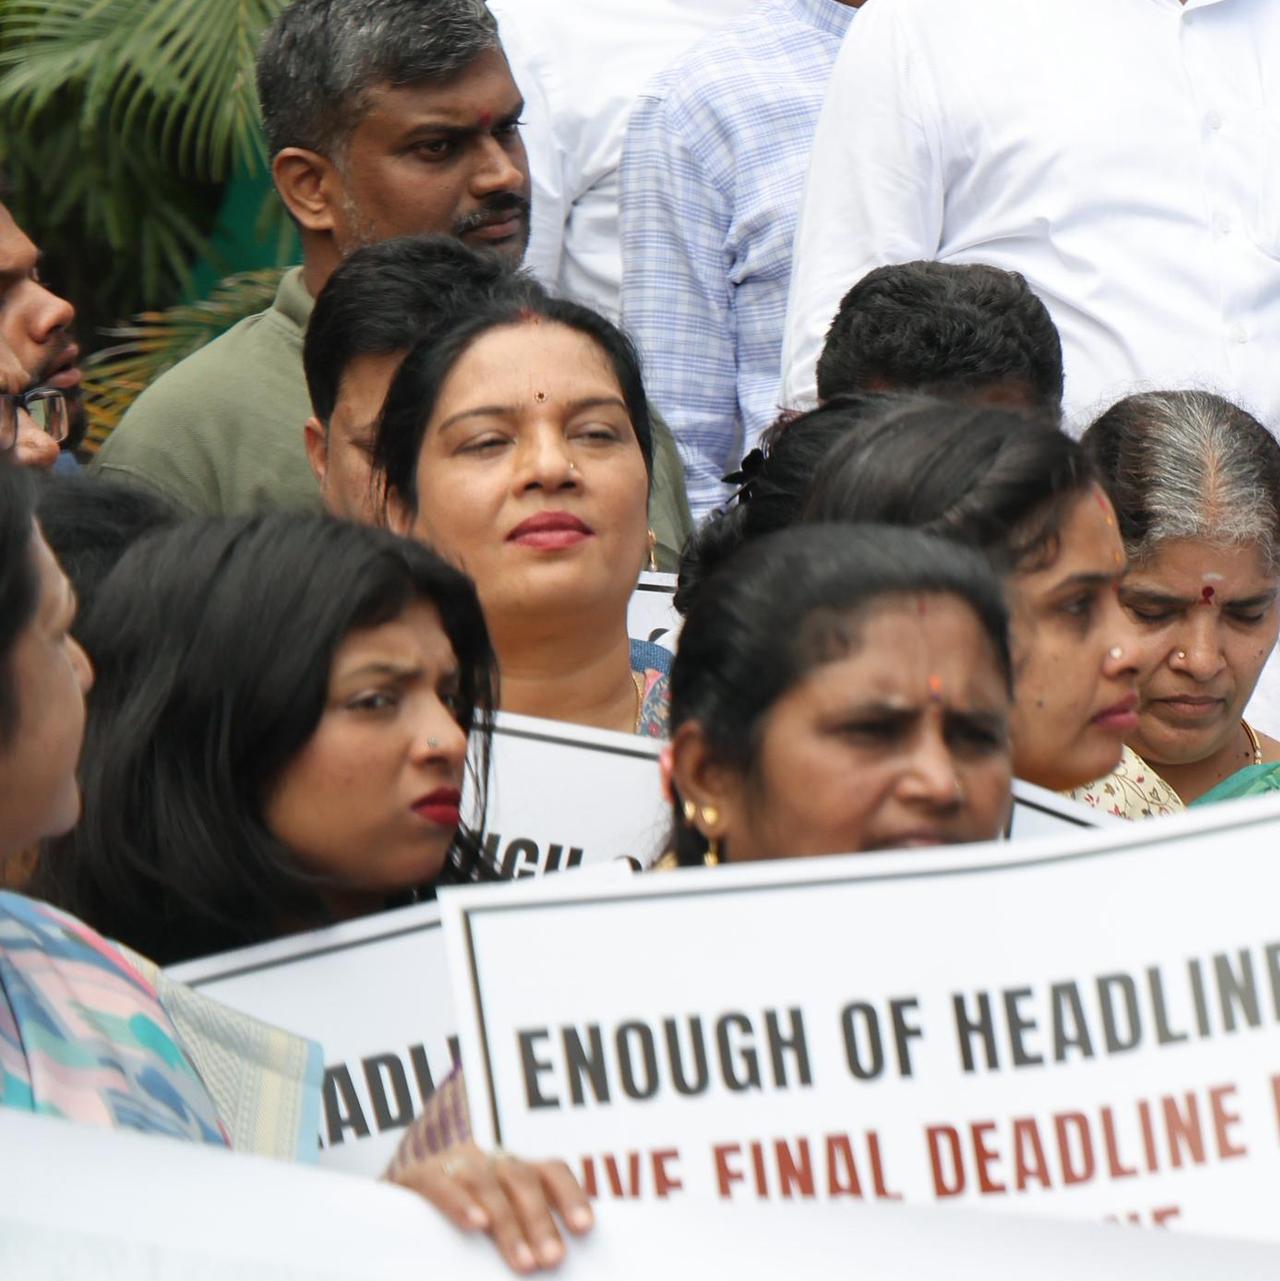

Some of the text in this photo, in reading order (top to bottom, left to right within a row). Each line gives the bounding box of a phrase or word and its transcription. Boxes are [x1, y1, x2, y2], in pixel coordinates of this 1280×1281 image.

[517, 1005, 814, 1110] ENOUGH
[840, 996, 923, 1082] OF
[713, 1129, 903, 1201] FINAL
[924, 1083, 1248, 1201] DEADLINE
